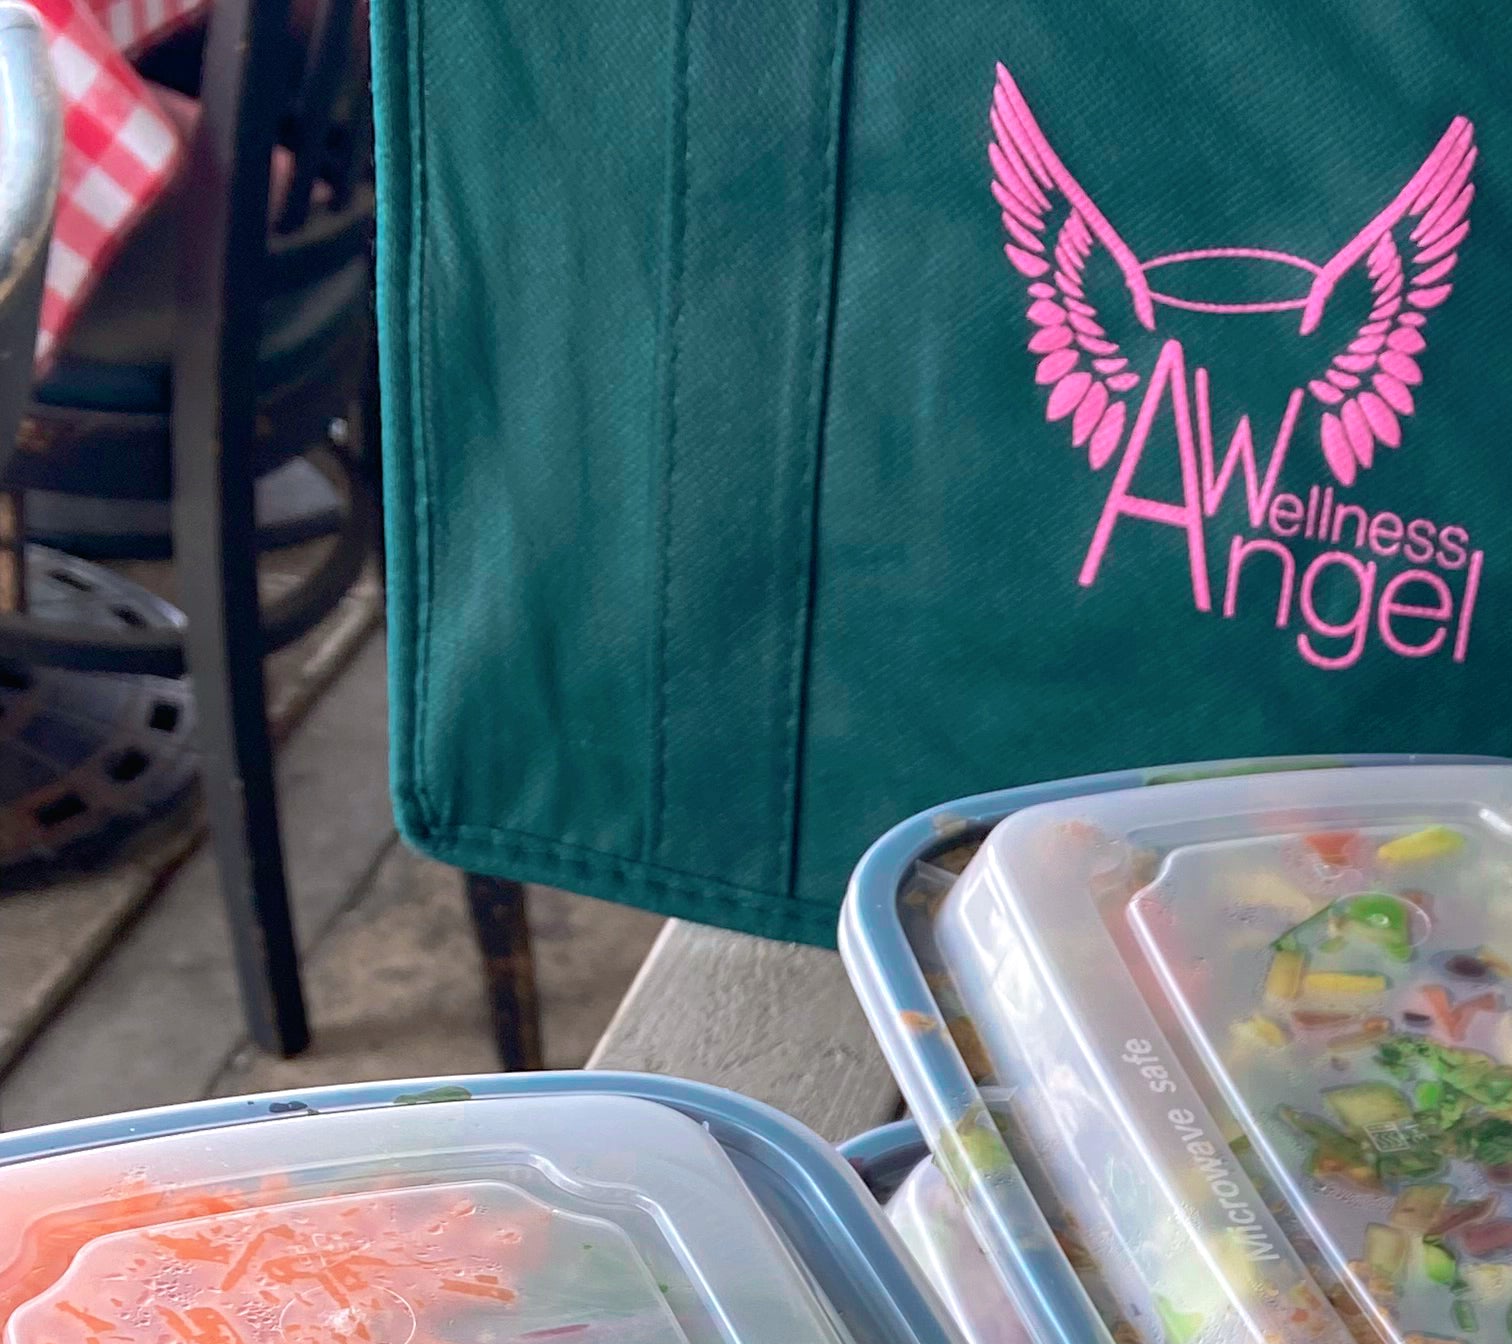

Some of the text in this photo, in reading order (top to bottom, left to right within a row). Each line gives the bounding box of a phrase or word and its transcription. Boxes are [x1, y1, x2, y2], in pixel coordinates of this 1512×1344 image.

[1079, 339, 1484, 671] Angel
[1195, 367, 1470, 570] Wellness
[1122, 1038, 1280, 1262] Microwave safe
